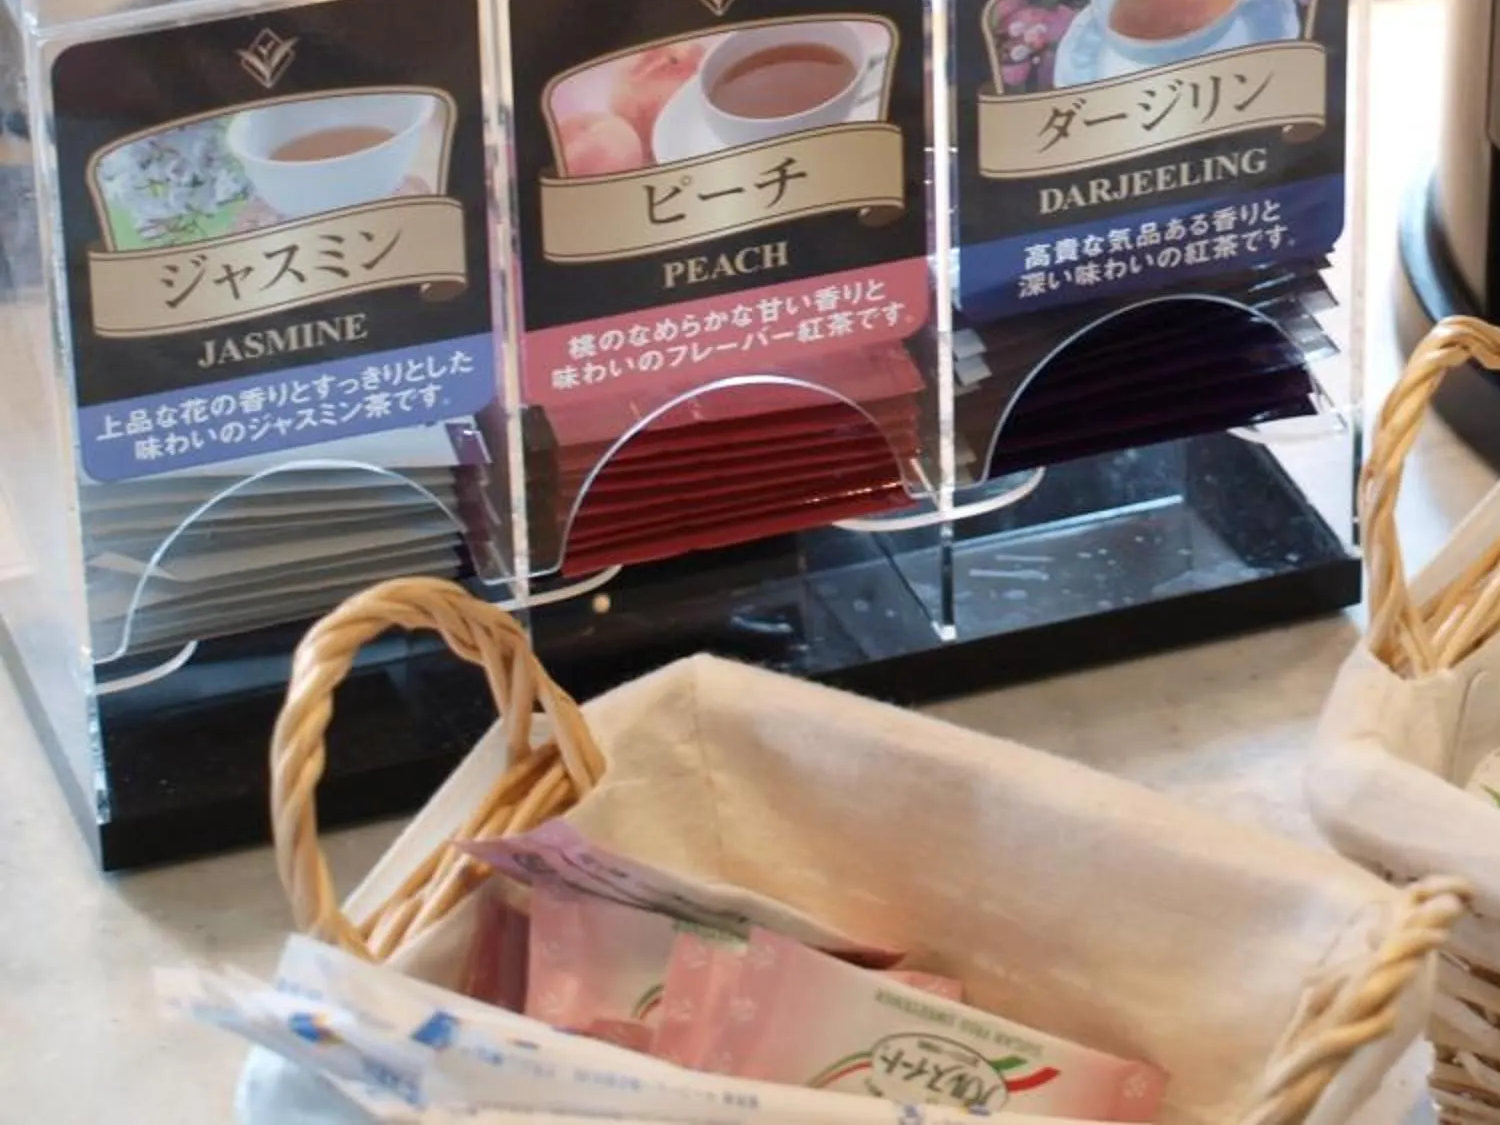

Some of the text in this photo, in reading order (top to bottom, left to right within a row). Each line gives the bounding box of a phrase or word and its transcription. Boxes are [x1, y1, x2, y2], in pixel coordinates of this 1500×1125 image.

[1037, 70, 1276, 152] ダージリン
[641, 157, 808, 226] ピーチ
[1039, 148, 1268, 215] DARJEELING
[158, 227, 403, 309] ジャスミン
[663, 240, 788, 289] PEACH
[1024, 200, 1282, 269] 高貴な気品ある香りと
[197, 312, 369, 369] JASMINE
